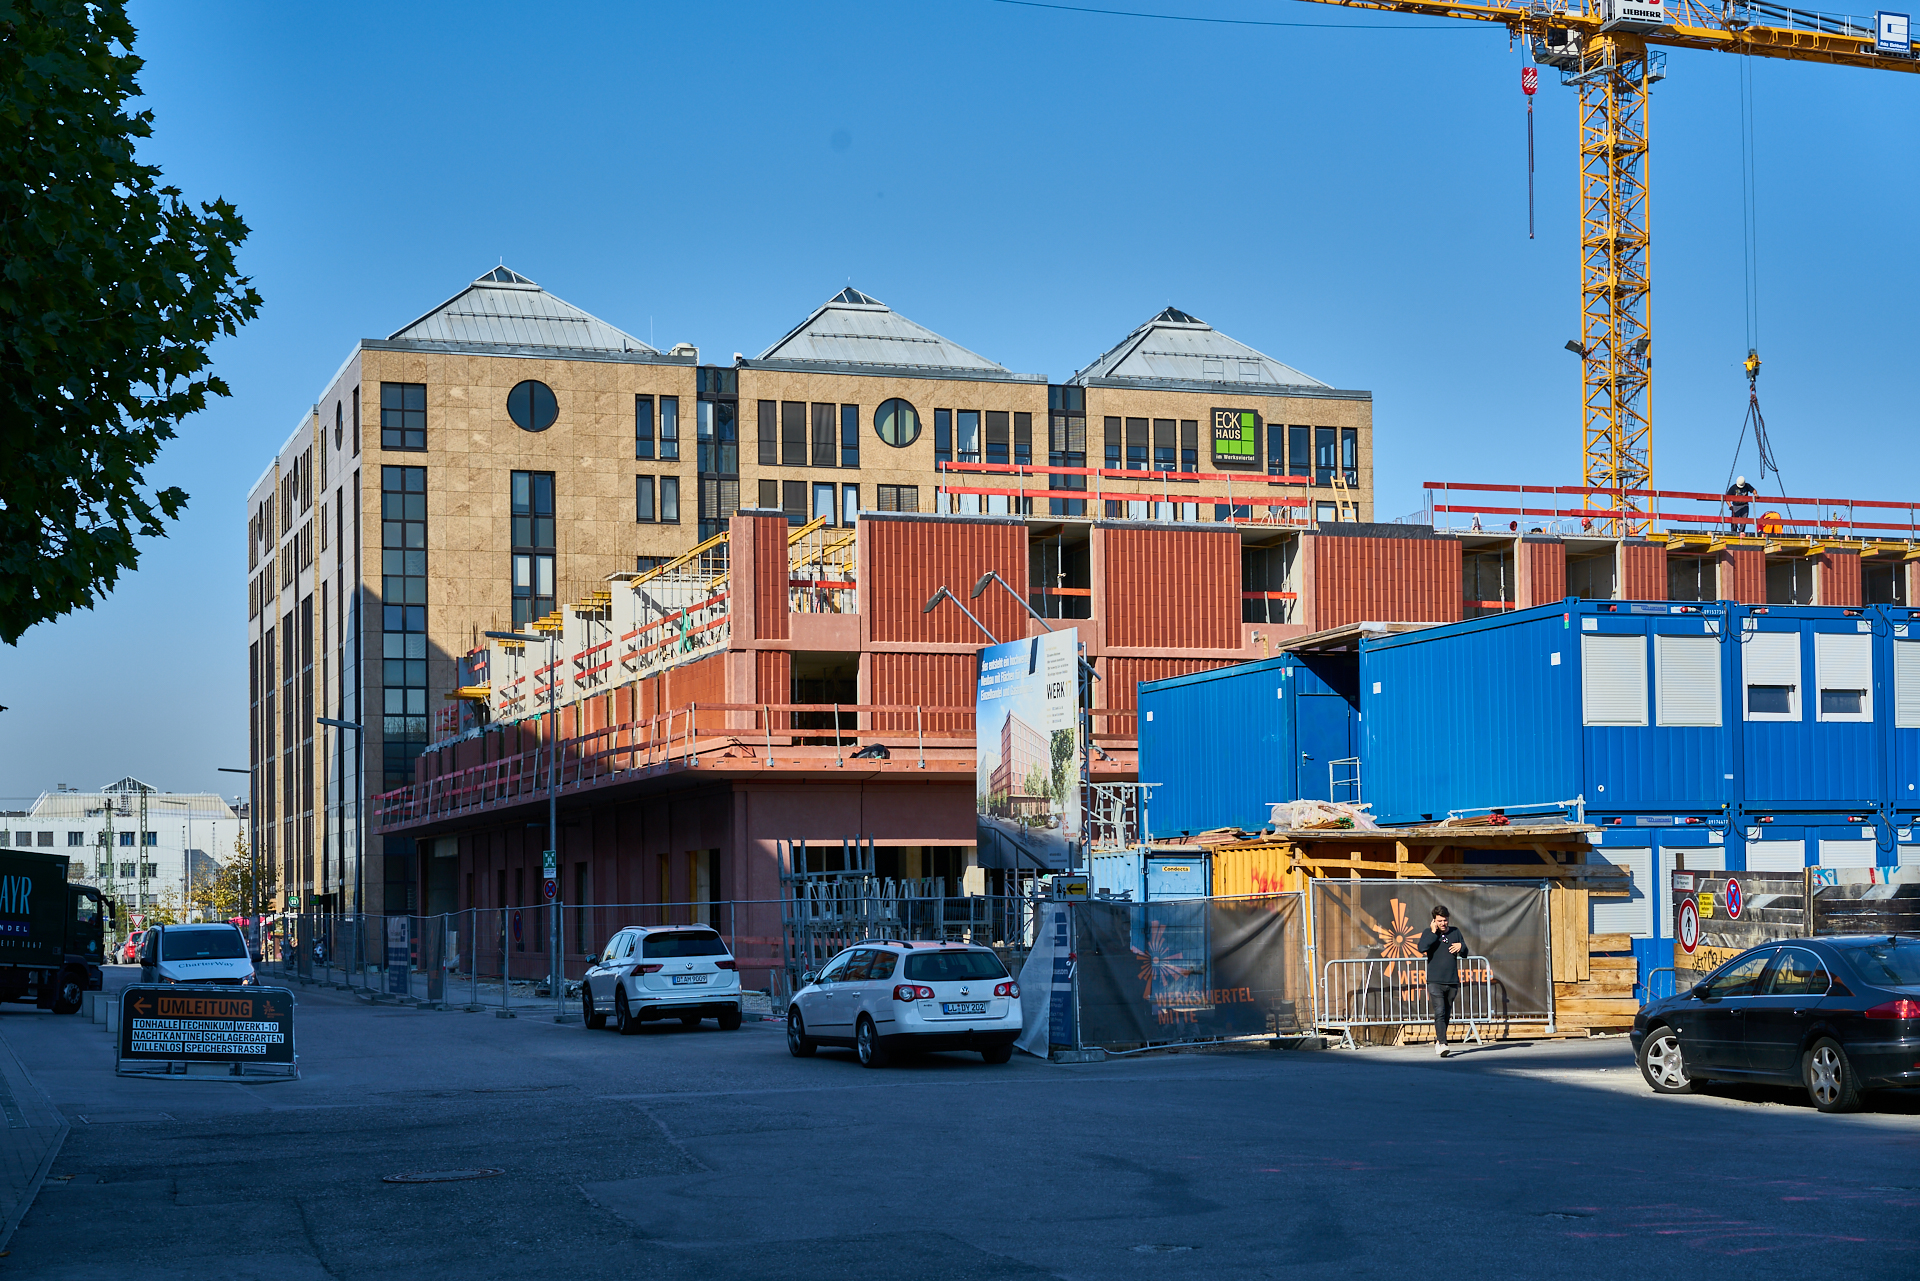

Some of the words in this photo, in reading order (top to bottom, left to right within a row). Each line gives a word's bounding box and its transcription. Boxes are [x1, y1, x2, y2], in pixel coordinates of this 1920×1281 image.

[1623, 8, 1661, 18] LIEBHERR
[1215, 411, 1240, 429] ECK
[1215, 429, 1240, 439] HAUS
[0, 875, 32, 914] AYR
[178, 961, 235, 969] CharterWay
[1155, 987, 1254, 1007] WERKSVIERTEL
[160, 999, 250, 1016] UMLEITUNG
[1158, 1009, 1198, 1025] MITTE
[134, 1019, 178, 1029] TONHALLE
[182, 1020, 233, 1031] TECHNIKUM
[236, 1022, 278, 1031] WERK1-10
[133, 1031, 201, 1041] NACHTKANTINE
[204, 1032, 283, 1043] SCHLAGERGARTEN
[133, 1042, 181, 1052] WILLENLOS
[186, 1044, 265, 1053] SPEICHERSTRASSE
